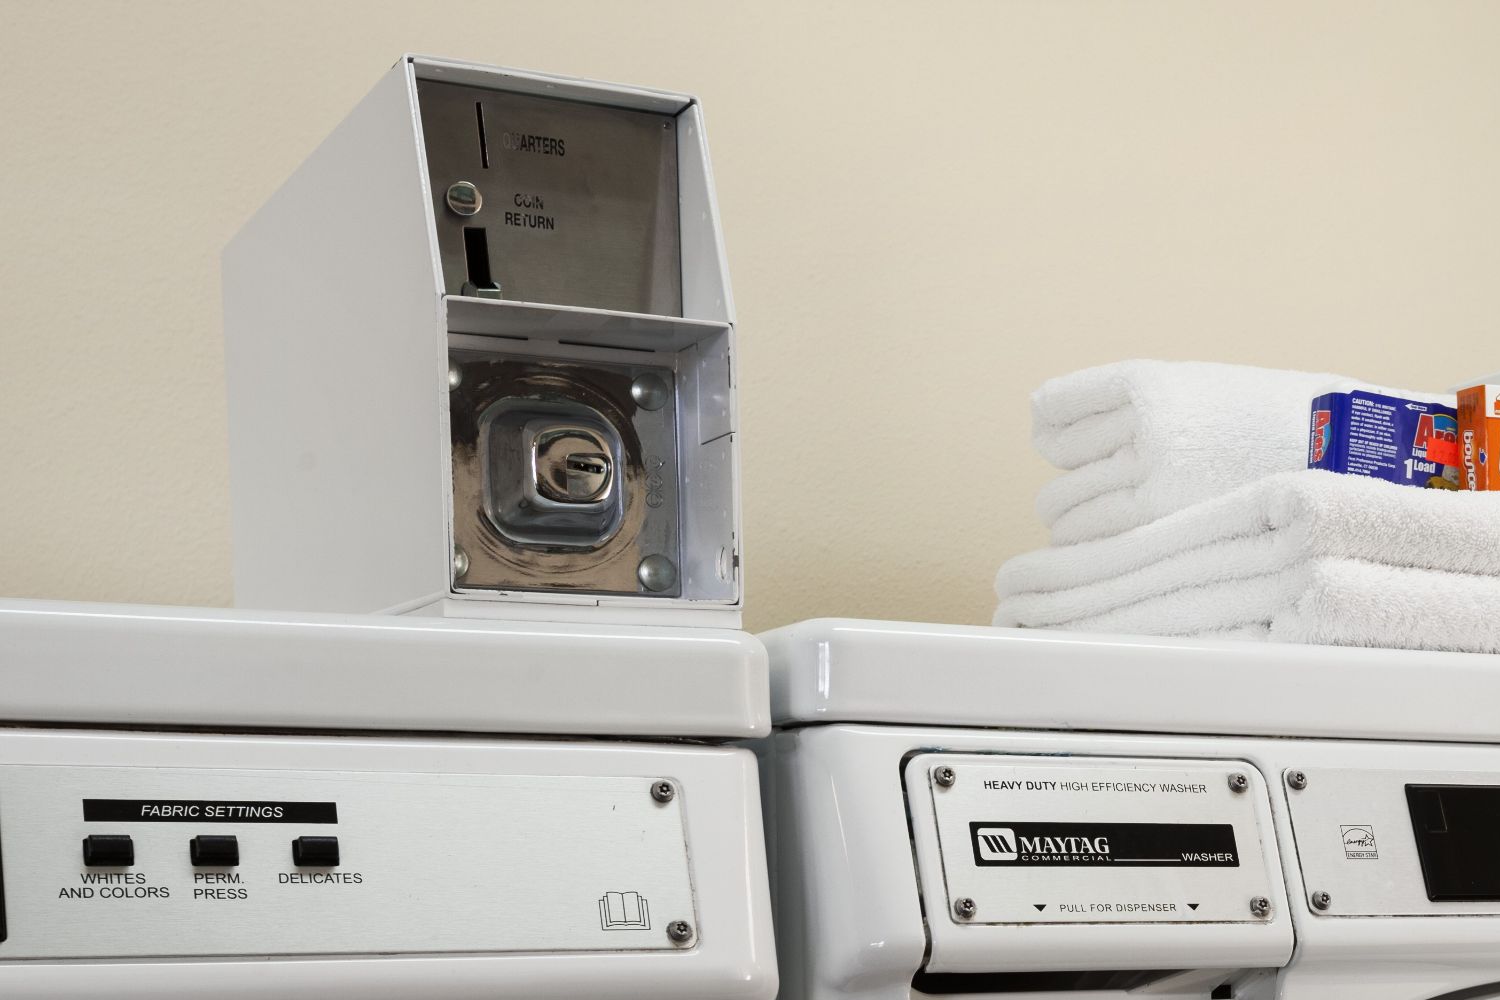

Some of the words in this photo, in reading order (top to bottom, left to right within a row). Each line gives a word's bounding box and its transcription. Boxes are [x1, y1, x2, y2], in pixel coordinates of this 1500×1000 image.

[513, 193, 544, 210] COIN
[504, 212, 555, 230] RETURN
[1312, 409, 1331, 463] Ares
[1404, 458, 1413, 479] 1
[1413, 459, 1436, 473] Load
[984, 780, 1023, 791] HEAVY
[1026, 781, 1057, 792] DUTY
[1060, 782, 1089, 792] HIGH
[1091, 782, 1157, 793] EFFICIENCY
[1160, 783, 1207, 793] WASHER
[140, 804, 201, 818] FABRIC
[204, 805, 285, 819] SETTINGS
[1020, 837, 1110, 854] MAYTAG
[1181, 853, 1234, 862] WASHER
[80, 873, 147, 885] WHITES
[194, 874, 245, 885] PERM.
[278, 873, 363, 885] DELICATES
[58, 887, 95, 899] AND
[98, 887, 170, 899] COLORS
[193, 888, 248, 900] PRESS
[1060, 904, 1087, 913] PULL
[1090, 904, 1113, 912] FOR
[1116, 903, 1177, 912] DISPENSER
